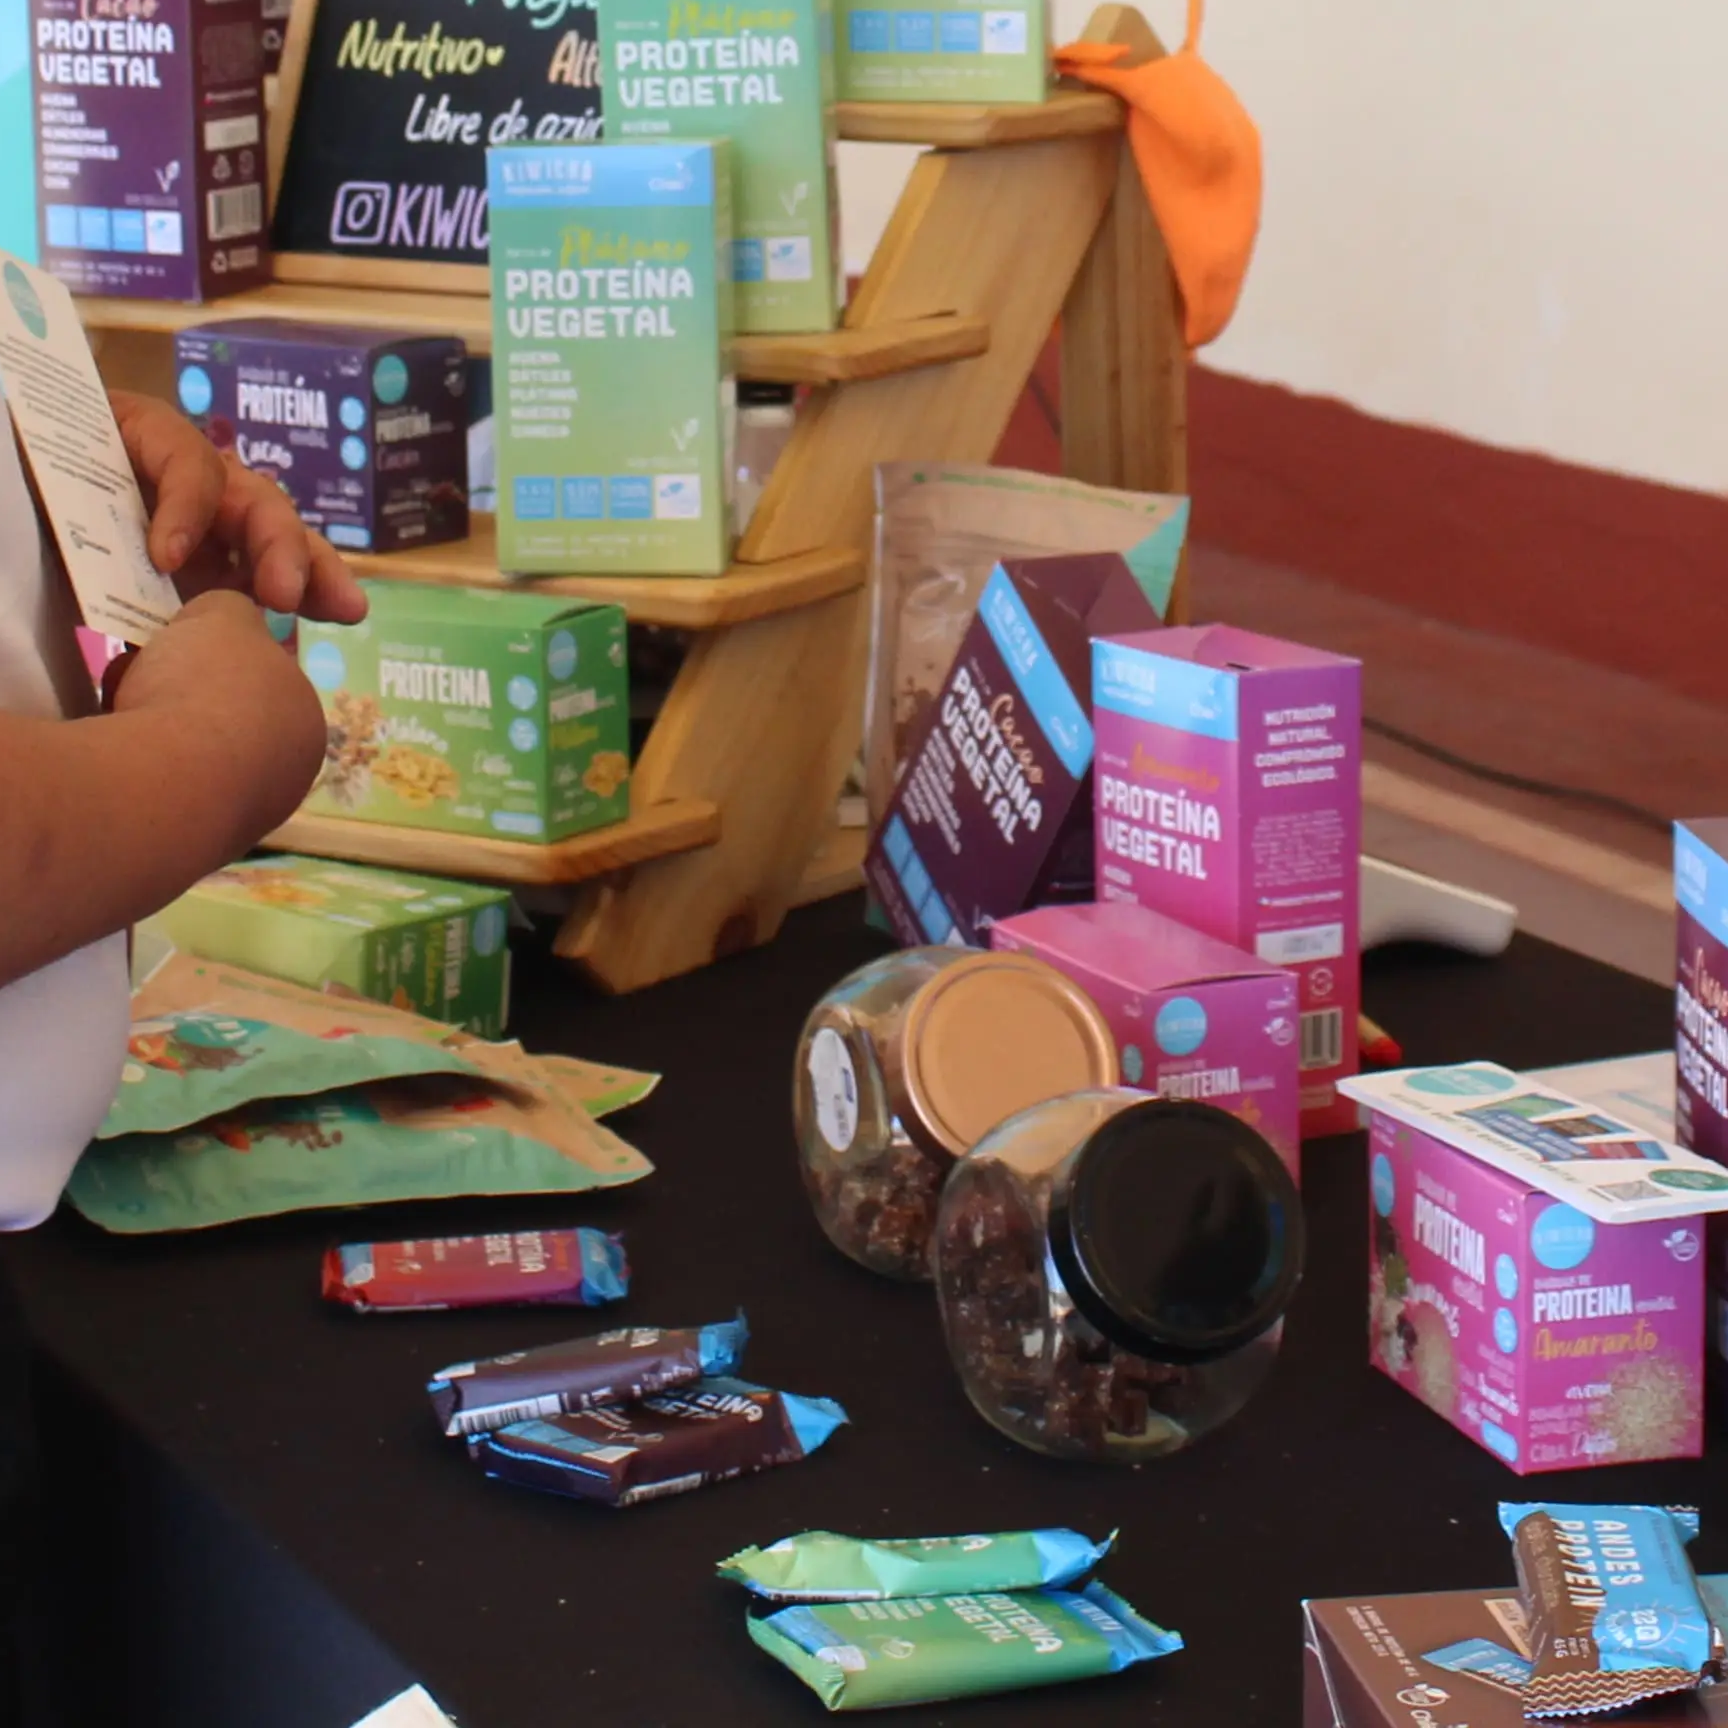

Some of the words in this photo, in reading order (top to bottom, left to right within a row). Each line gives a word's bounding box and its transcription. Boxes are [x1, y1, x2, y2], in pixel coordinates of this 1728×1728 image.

[37, 16, 174, 54] PROTEÍNA
[337, 19, 484, 79] Nutritivo
[548, 30, 603, 88] Alt
[616, 30, 799, 72] PROTEÍNA
[39, 52, 160, 87] VEGETAL
[619, 74, 783, 109] VEGETAL
[405, 94, 482, 144] Libre
[488, 99, 526, 142] de
[389, 183, 489, 249] KIWIC
[505, 260, 694, 302] PROTEÍNA
[507, 306, 675, 338] VEGETAL
[990, 694, 1045, 785] Cacao
[942, 694, 1018, 845] VEGETAL
[1101, 774, 1221, 841] PROTEÍNA
[1102, 815, 1207, 881] VEGETAL
[1533, 1284, 1633, 1323] PROTEINA
[1534, 1318, 1658, 1361] Amaranto
[1551, 1518, 1607, 1607] PROTEIN
[1592, 1520, 1644, 1586] ANDES
